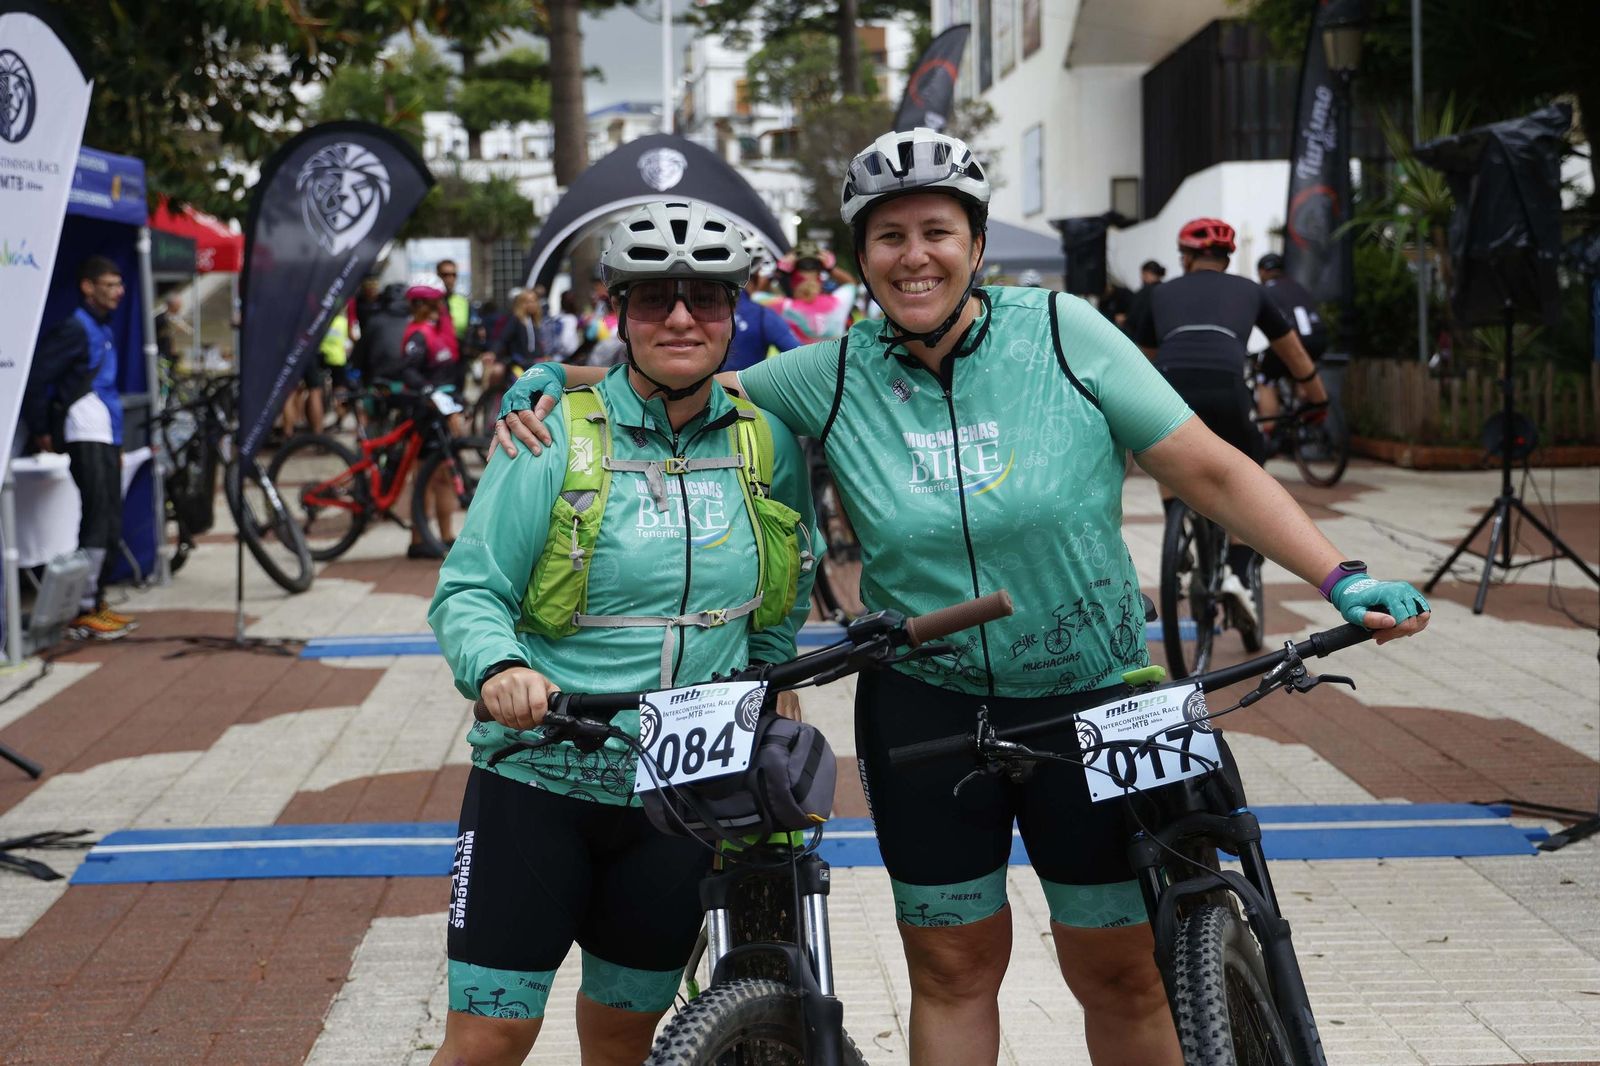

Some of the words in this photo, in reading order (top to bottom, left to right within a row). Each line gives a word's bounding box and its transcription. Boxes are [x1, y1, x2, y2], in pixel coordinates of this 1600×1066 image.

[903, 421, 998, 447] MUCHACHAS
[908, 440, 1003, 484] BIKE
[635, 480, 723, 498] MHACHAS
[908, 482, 950, 494] Tenerife
[636, 495, 729, 530] BIKE
[636, 528, 680, 539] Tenerife
[1009, 633, 1039, 661] Bike
[1023, 651, 1081, 672] MUCHACHAS
[688, 709, 703, 720] MTB
[1132, 720, 1149, 730] MTB
[656, 721, 735, 780] 084
[1106, 724, 1194, 788] 017
[454, 830, 475, 928] MUCHACHAS
